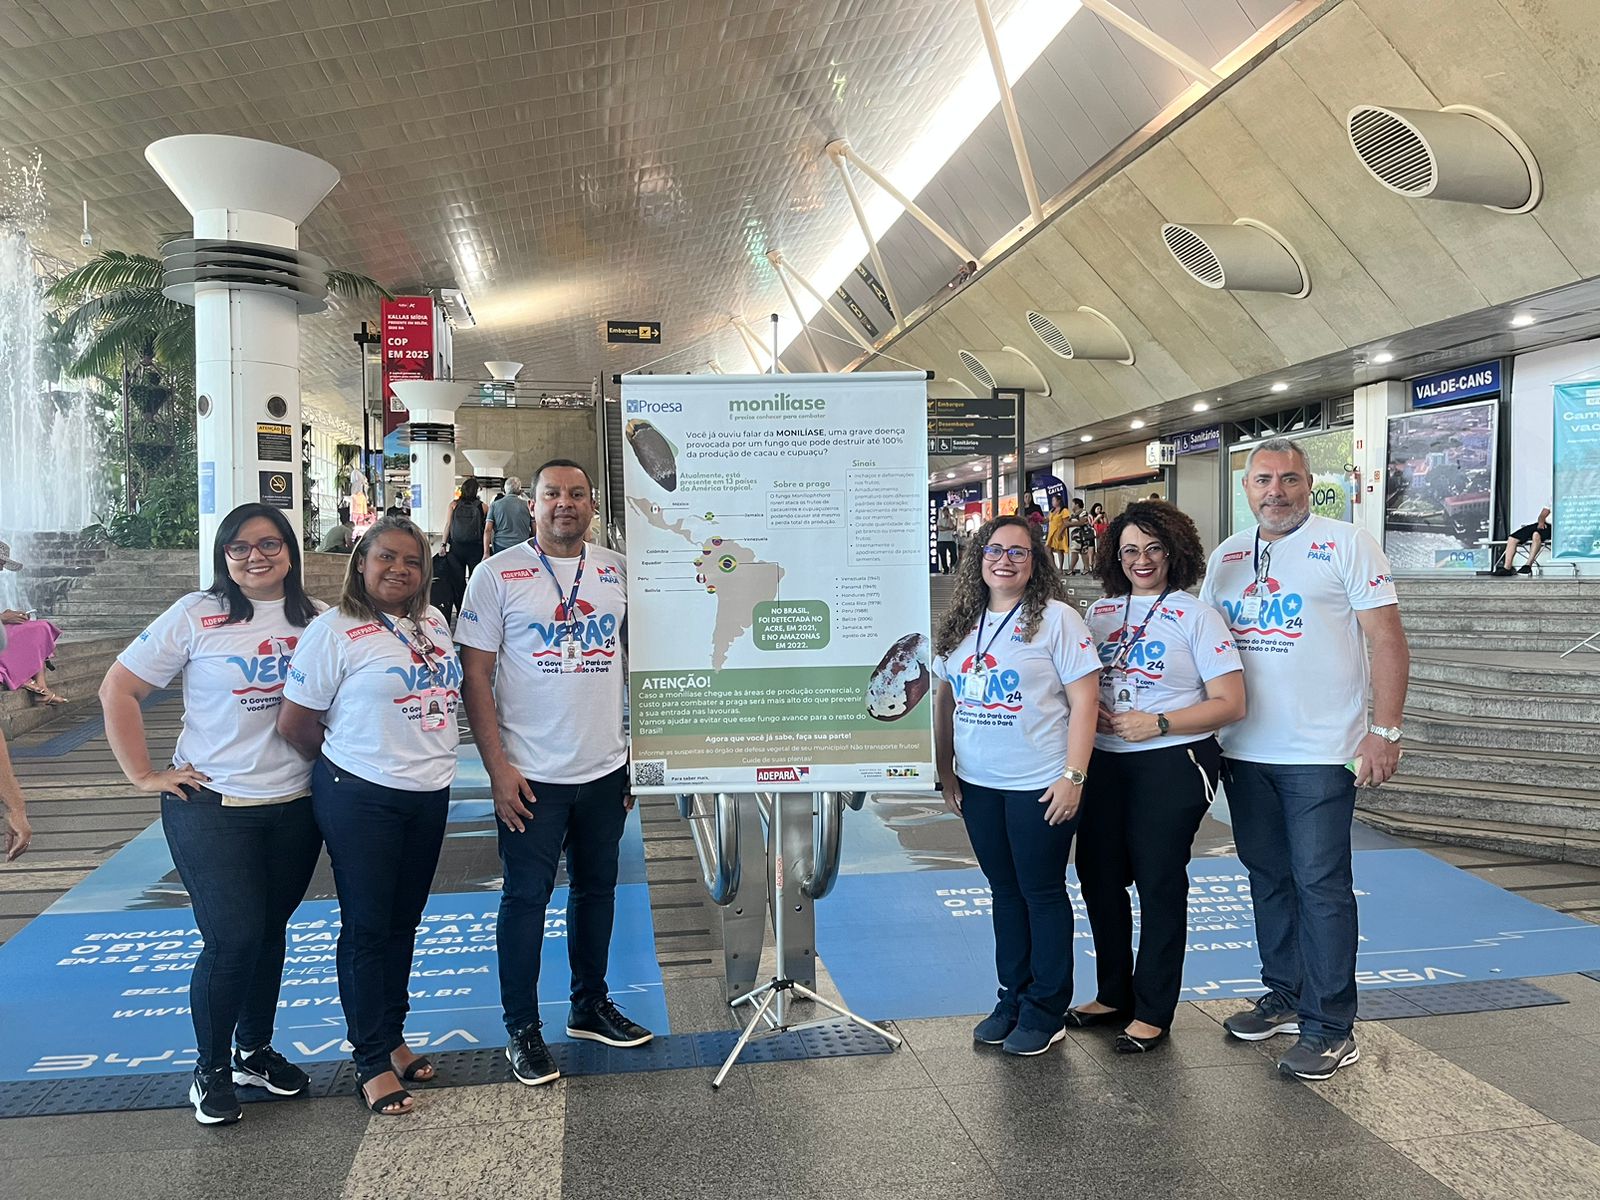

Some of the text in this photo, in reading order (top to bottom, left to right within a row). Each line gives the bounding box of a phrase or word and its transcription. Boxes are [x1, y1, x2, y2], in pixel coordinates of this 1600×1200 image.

[388, 338, 408, 346] COP
[1416, 370, 1493, 400] VAL-DE-CANS
[639, 400, 682, 413] Proesa
[729, 393, 826, 411] monilíase
[708, 431, 716, 440] já
[776, 428, 826, 437] MONILÍASE,
[874, 428, 905, 436] doença
[1191, 430, 1219, 443] Sanitários
[686, 440, 730, 449] provocada
[732, 441, 746, 449] por
[764, 440, 789, 448] fungo
[699, 450, 739, 459] produção
[787, 448, 829, 456] cupuaçu?
[723, 484, 753, 492] tropical.
[773, 480, 796, 488] Sobre
[1308, 550, 1331, 562] PARÁ
[1285, 617, 1303, 629] 24
[605, 636, 615, 648] 24
[1147, 661, 1165, 671] 24
[642, 674, 710, 691] ATENÇÃO!
[666, 690, 702, 698] monilíase
[704, 690, 732, 698] chegue
[778, 687, 813, 697] produção
[815, 687, 854, 695] comercial,
[1006, 691, 1022, 703] 24
[249, 696, 281, 704] Governo
[680, 699, 717, 707] combater
[831, 696, 862, 704] prevenir
[661, 708, 690, 716] entrada
[667, 717, 691, 725] ajudar
[699, 716, 721, 724] evitar
[757, 715, 780, 723] fungo
[705, 735, 728, 743] Agora
[766, 733, 773, 742] já
[775, 733, 794, 741] sabe,
[796, 733, 812, 741] faça
[944, 899, 966, 907] O
[435, 925, 459, 934] A
[422, 936, 464, 945] 531
[71, 941, 183, 954] O BYD
[56, 955, 142, 966] EM 3.5
